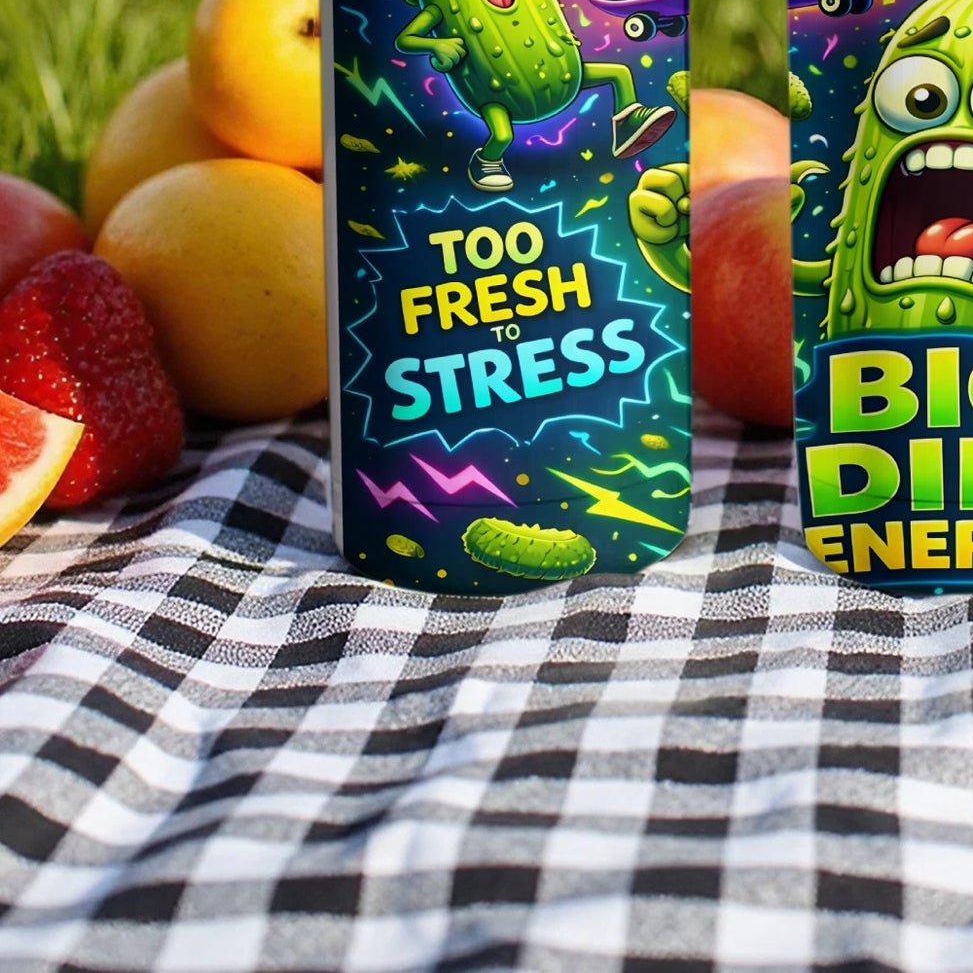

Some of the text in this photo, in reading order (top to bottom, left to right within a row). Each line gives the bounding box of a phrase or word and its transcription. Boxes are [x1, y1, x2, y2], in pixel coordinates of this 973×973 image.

[429, 221, 543, 274] TOO
[401, 262, 591, 335] FRESH
[490, 323, 520, 342] TO
[385, 318, 645, 421] STRESS
